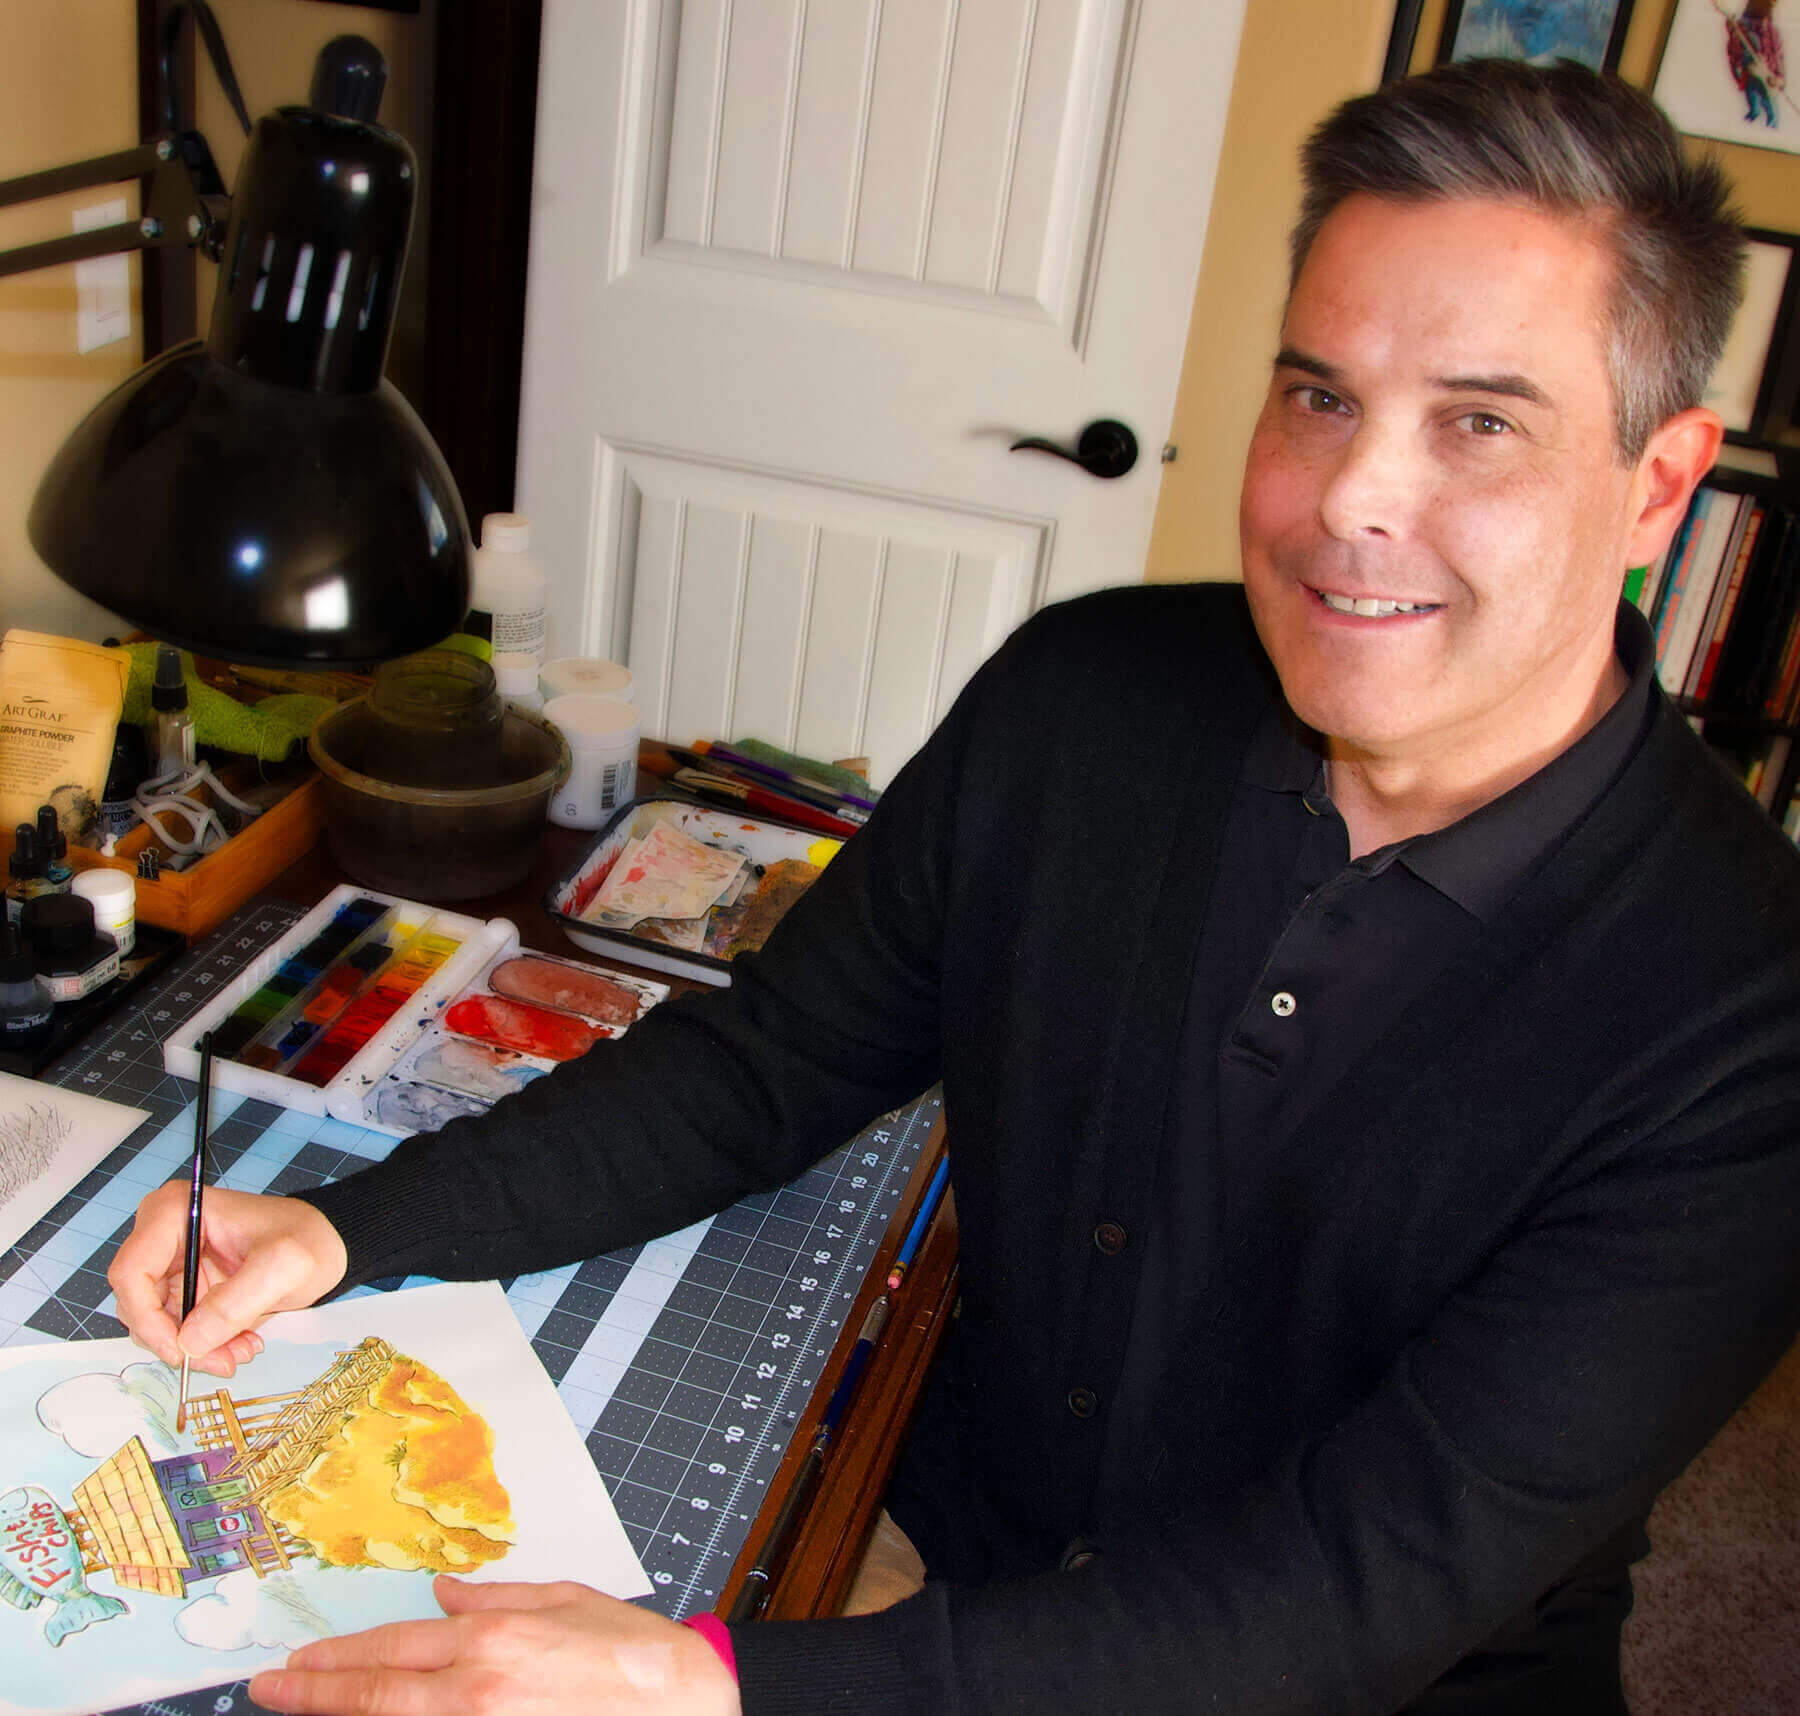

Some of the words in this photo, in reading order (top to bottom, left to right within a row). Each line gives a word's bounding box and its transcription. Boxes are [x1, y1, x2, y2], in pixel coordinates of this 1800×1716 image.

[39, 730, 75, 743] POWDER
[216, 954, 235, 967] 21
[195, 971, 214, 985] 20
[174, 991, 193, 1003] 19
[151, 1009, 172, 1022] 18
[130, 1030, 148, 1041] 17
[106, 1049, 126, 1062] 16
[82, 1071, 102, 1084] 15
[873, 1130, 891, 1144] 21
[862, 1152, 879, 1168] 20
[850, 1175, 868, 1189] 19
[838, 1199, 856, 1213] 18
[825, 1223, 844, 1239] 17
[813, 1250, 832, 1265] 16
[800, 1276, 819, 1292] 15
[785, 1304, 806, 1320] 14
[770, 1333, 791, 1350] 13
[756, 1362, 778, 1380] 12
[740, 1393, 762, 1411] 11
[724, 1425, 745, 1444] 10
[707, 1463, 727, 1475] 9
[690, 1497, 710, 1511] 8
[29, 1502, 70, 1548] Chips
[671, 1531, 691, 1546] 7
[6, 1530, 72, 1589] Fish
[653, 1571, 673, 1585] 6
